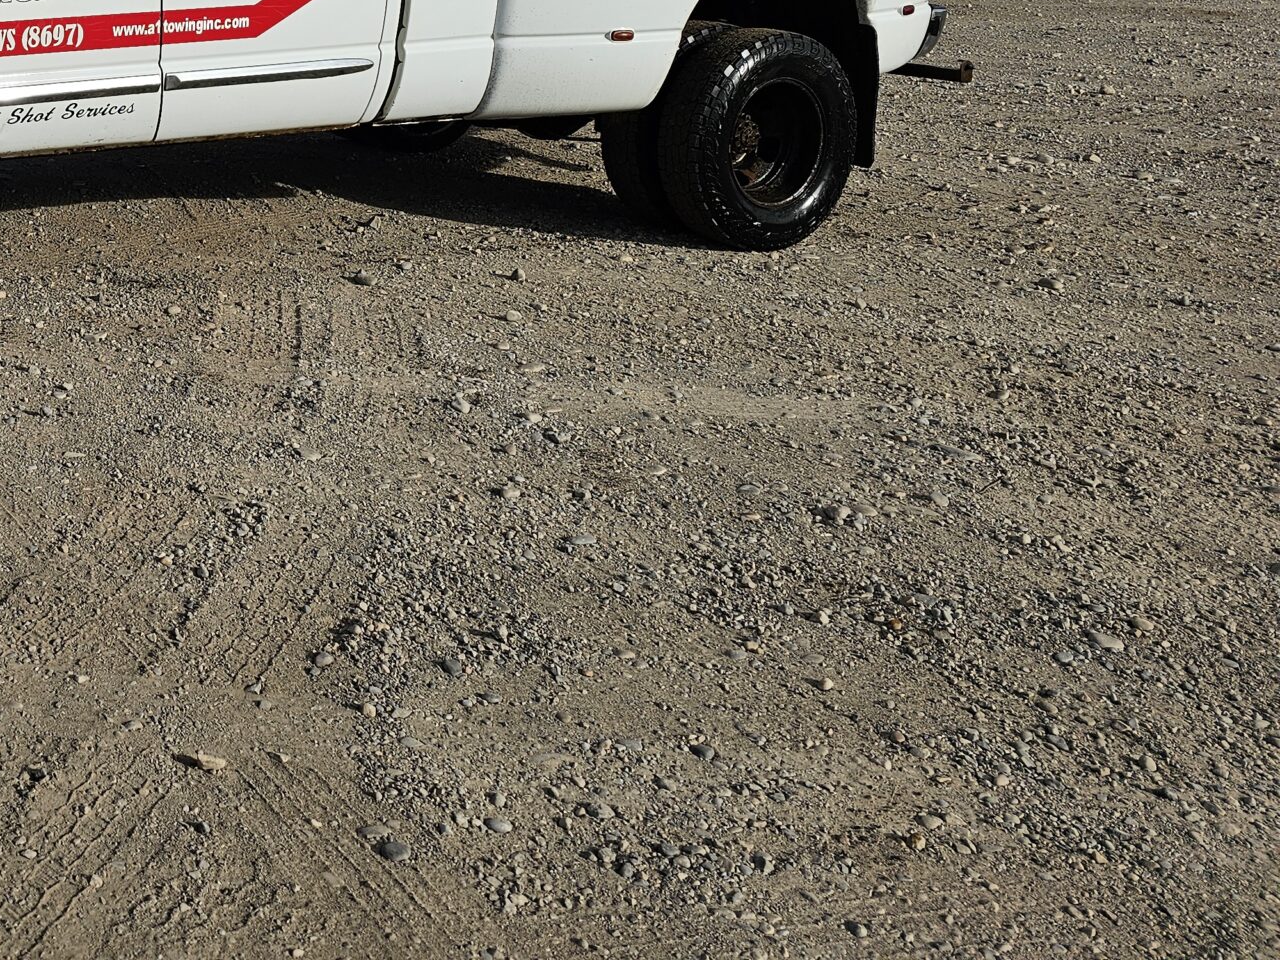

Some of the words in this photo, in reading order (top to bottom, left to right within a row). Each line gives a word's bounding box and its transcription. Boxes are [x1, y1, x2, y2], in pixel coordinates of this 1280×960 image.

[21, 23, 84, 51] (8697)
[112, 16, 250, 37] www.a1towinginc.com
[7, 107, 56, 125] Shot
[61, 102, 136, 120] Services
